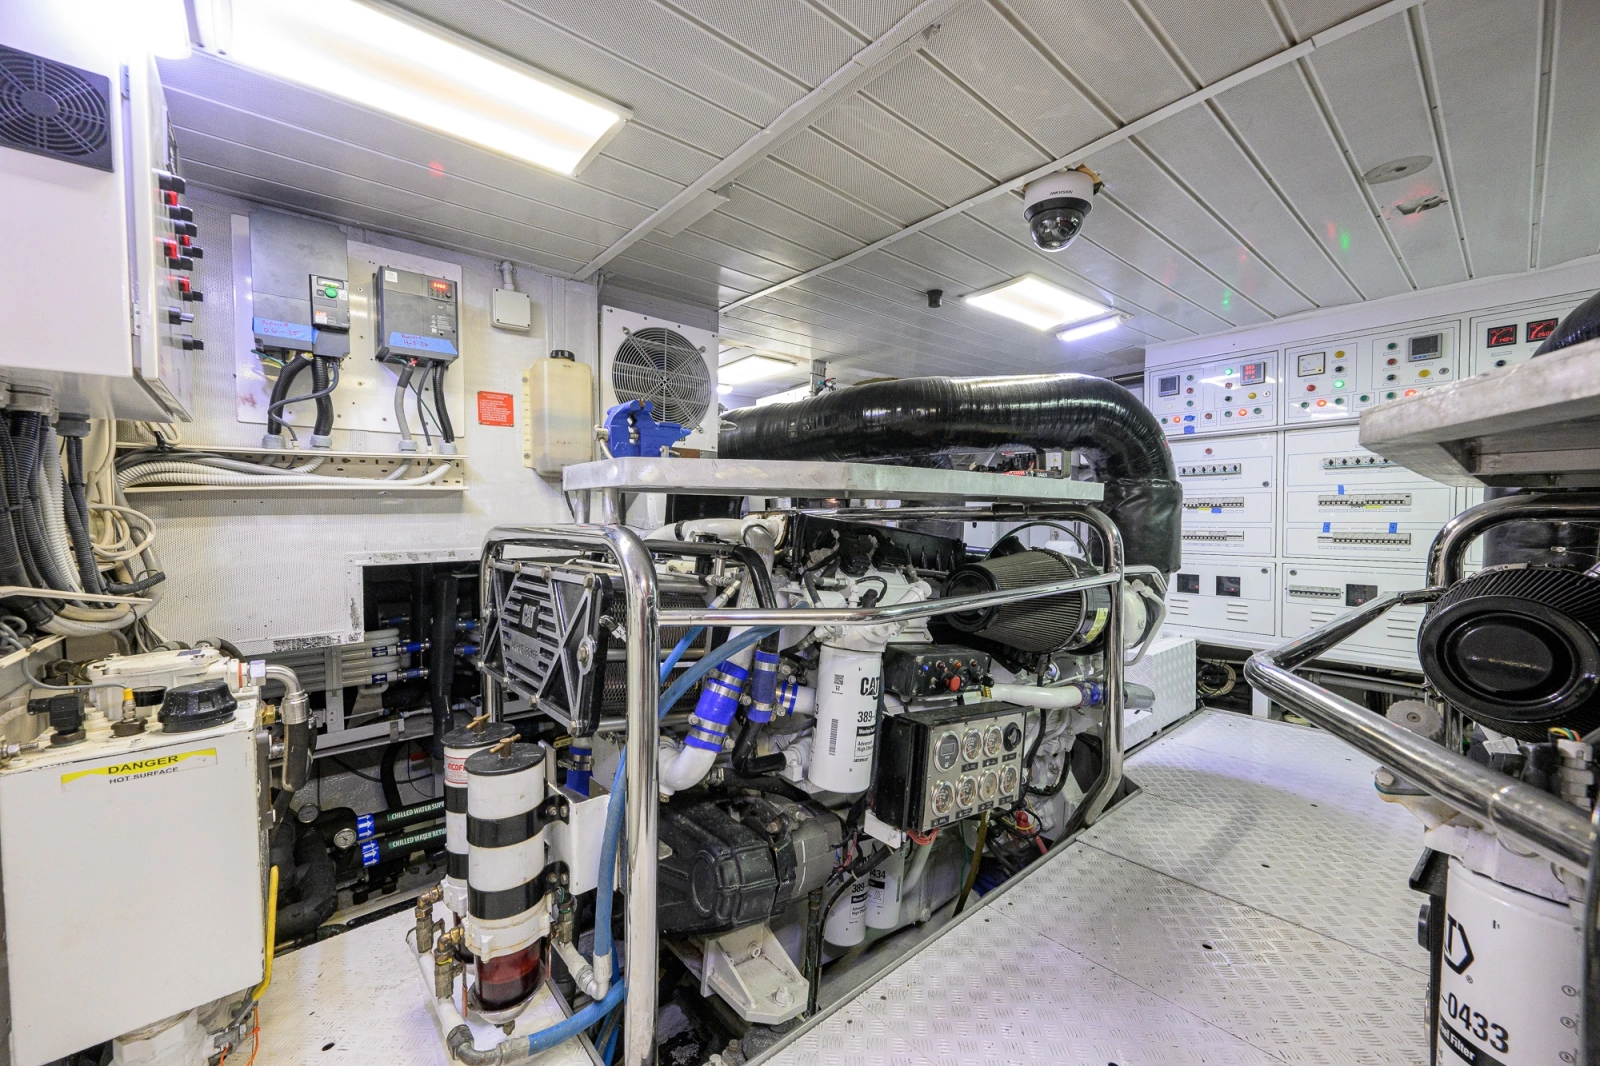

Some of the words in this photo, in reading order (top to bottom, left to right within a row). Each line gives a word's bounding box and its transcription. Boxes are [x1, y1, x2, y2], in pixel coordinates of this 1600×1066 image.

[521, 603, 536, 629] CAT
[860, 677, 880, 700] CAT
[108, 755, 178, 775] DANGER
[109, 775, 130, 784] HOT
[133, 766, 179, 780] SURFACE
[391, 808, 414, 821] CHILLED
[414, 804, 432, 815] WATER
[392, 836, 414, 848] CHILLED
[414, 831, 432, 843] WATER
[1450, 1032, 1477, 1061] Filter
